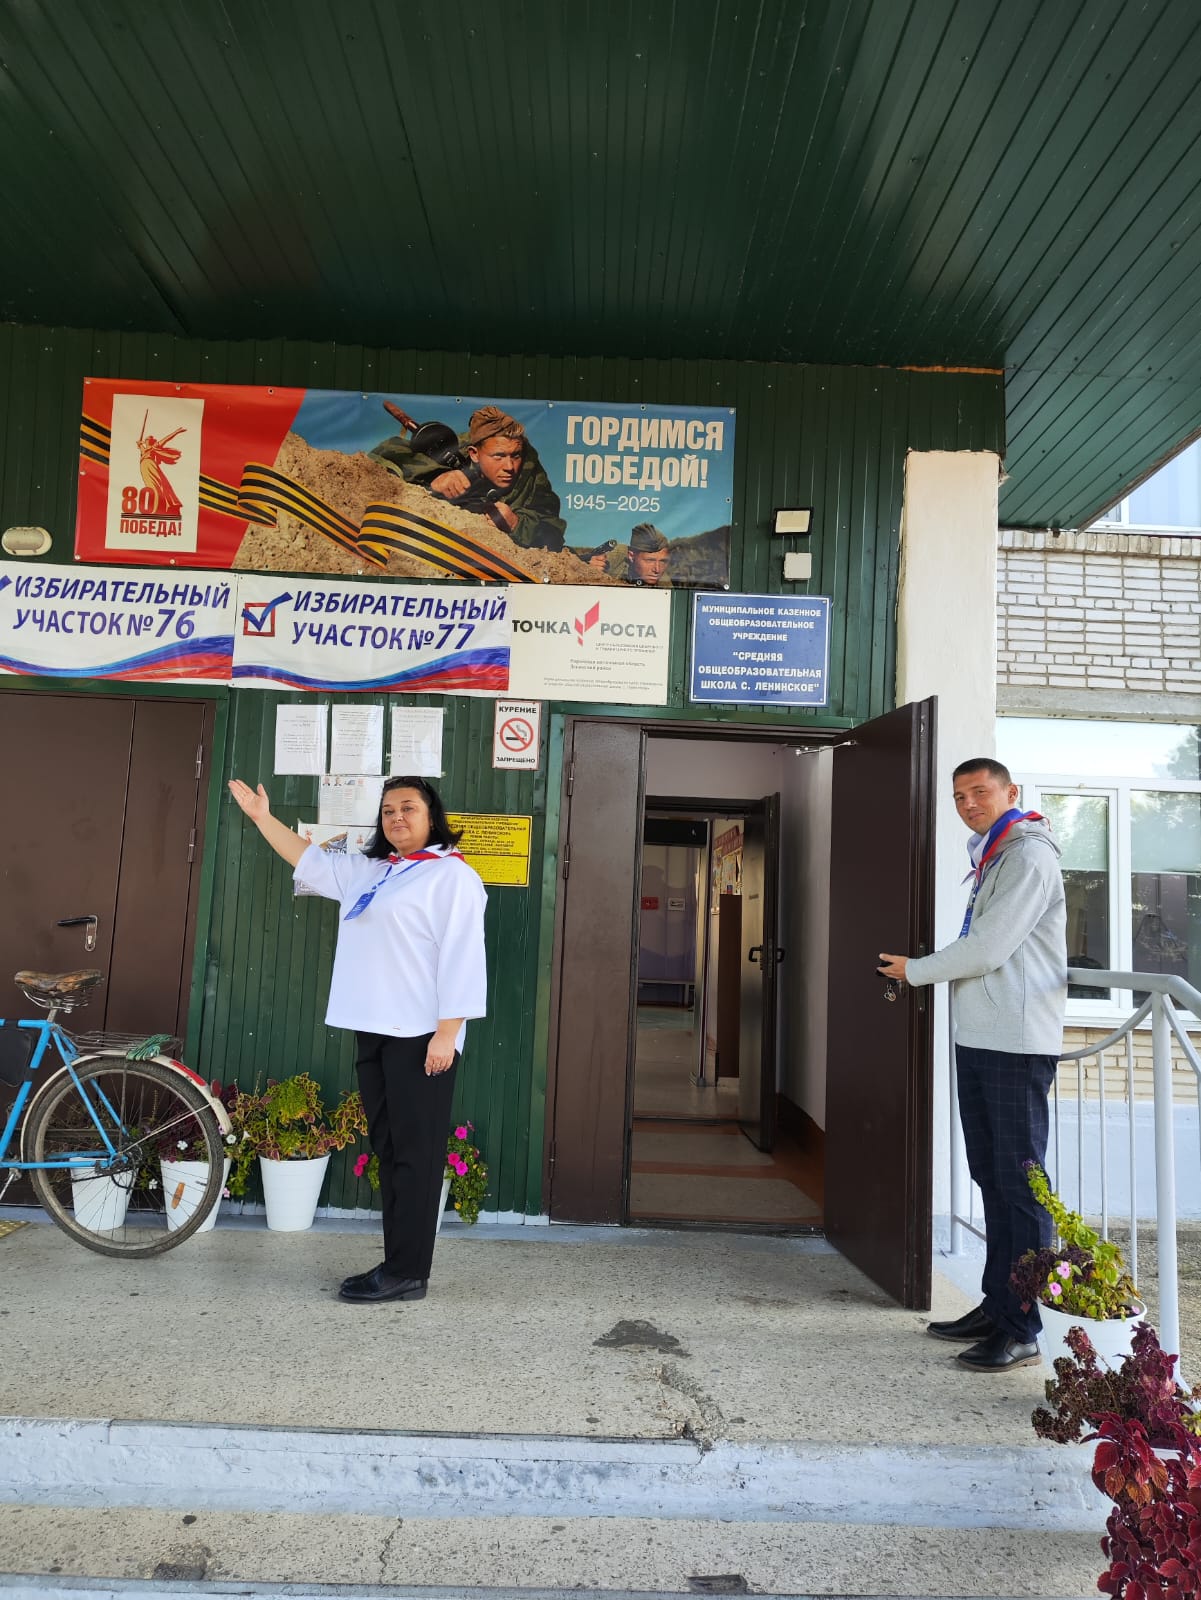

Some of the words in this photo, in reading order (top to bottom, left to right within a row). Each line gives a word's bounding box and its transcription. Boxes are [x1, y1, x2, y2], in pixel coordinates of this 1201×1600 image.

[566, 415, 724, 452] ГОРДИМСЯ
[565, 453, 709, 491] ПОБЕДОЙ!
[121, 486, 156, 514] 80
[119, 519, 182, 538] ПОБЕДА!
[15, 575, 231, 609] ИЗБИРАТЕЛЬНЫЙ
[293, 590, 507, 621] ИЗБИРАТЕЛЬНЫЙ
[702, 605, 775, 616] МУНИЦИПАЛЬНОЕ
[777, 608, 822, 617] КАЗЕННОЕ
[511, 619, 571, 635] ТОЧКА
[600, 623, 657, 638] РОСТА
[708, 618, 815, 629] ОБЩЕОБРАЗОВАТЕЛЬНОЕ
[732, 632, 788, 642] УЧРЕЖДЕНИЕ
[698, 665, 822, 678] ОБЩЕОБРАЗОВАТЕЛЬНАЯ
[701, 680, 737, 690] ШКОЛА
[498, 705, 537, 714] КУРЕНИЕ
[495, 756, 536, 764] ЗАПРЕЩЕНО
